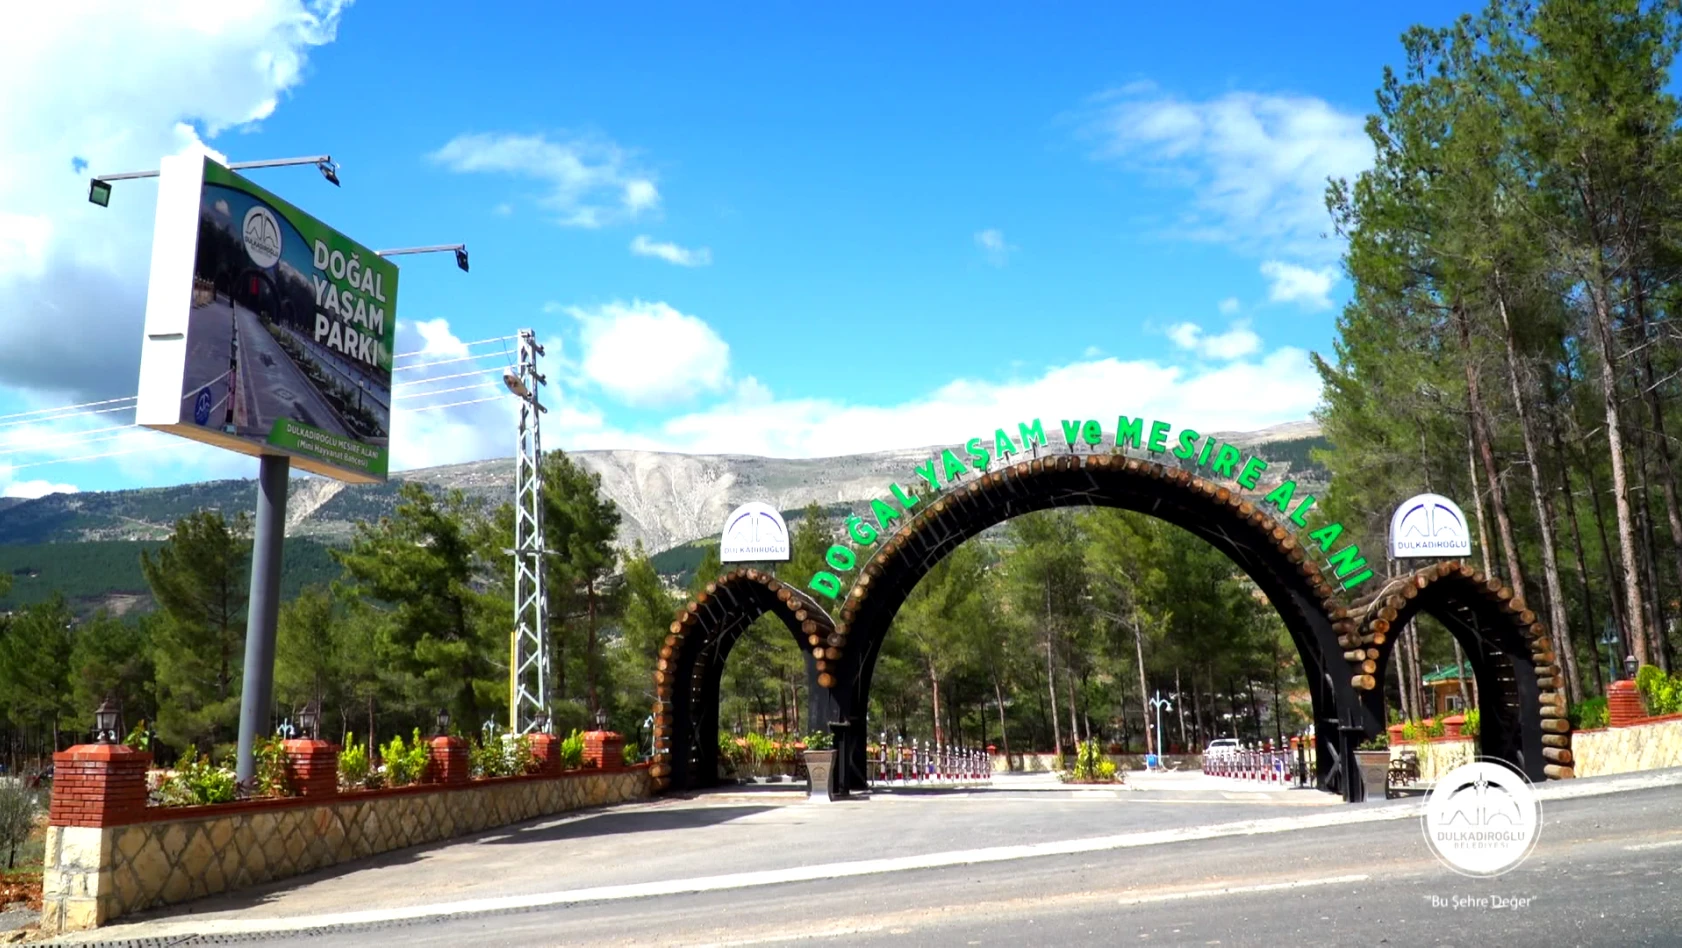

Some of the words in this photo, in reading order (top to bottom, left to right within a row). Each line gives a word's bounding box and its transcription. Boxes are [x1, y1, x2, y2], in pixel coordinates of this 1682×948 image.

[313, 239, 386, 303] DOĞAL
[313, 274, 384, 336] YAŞAM
[314, 312, 378, 367] PARKI
[808, 481, 920, 600] DOĞAL
[914, 418, 1048, 491] YAŞAM
[1061, 419, 1102, 446] ve
[1263, 479, 1375, 592] ALANI
